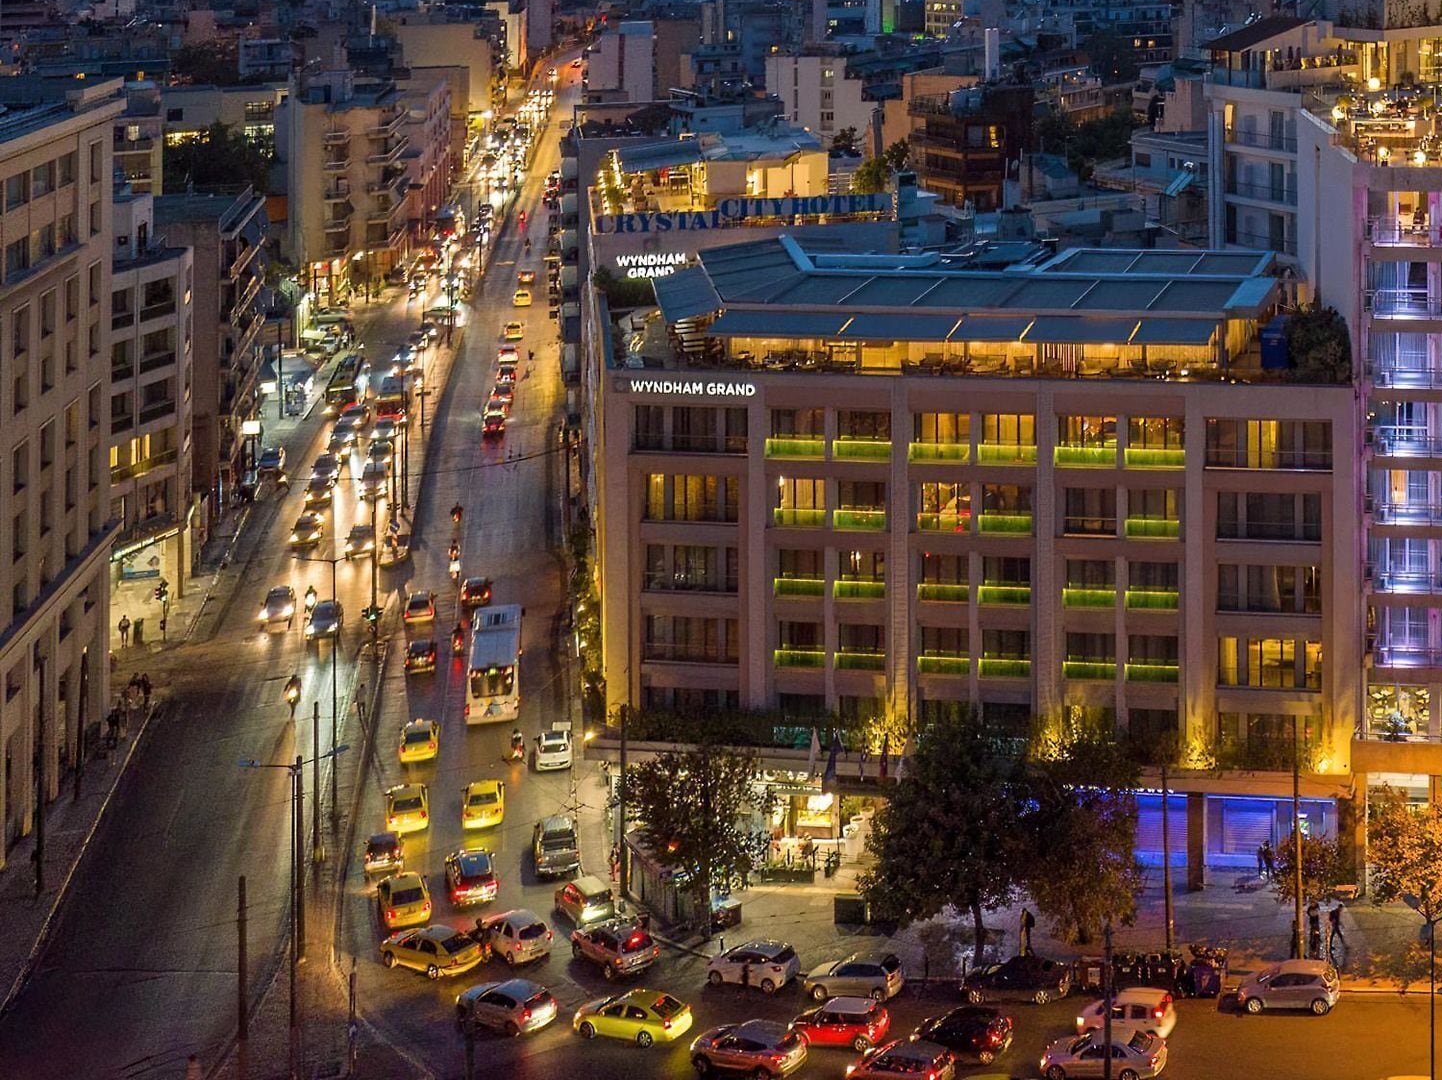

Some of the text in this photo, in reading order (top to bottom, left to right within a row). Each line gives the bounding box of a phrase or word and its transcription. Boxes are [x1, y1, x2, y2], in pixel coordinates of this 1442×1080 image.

[720, 197, 785, 218] CITY
[791, 193, 885, 216] HOTEL
[616, 252, 687, 267] WYNDHAM
[626, 265, 675, 279] GRAND
[630, 379, 756, 397] WYNDHAM GRAND
